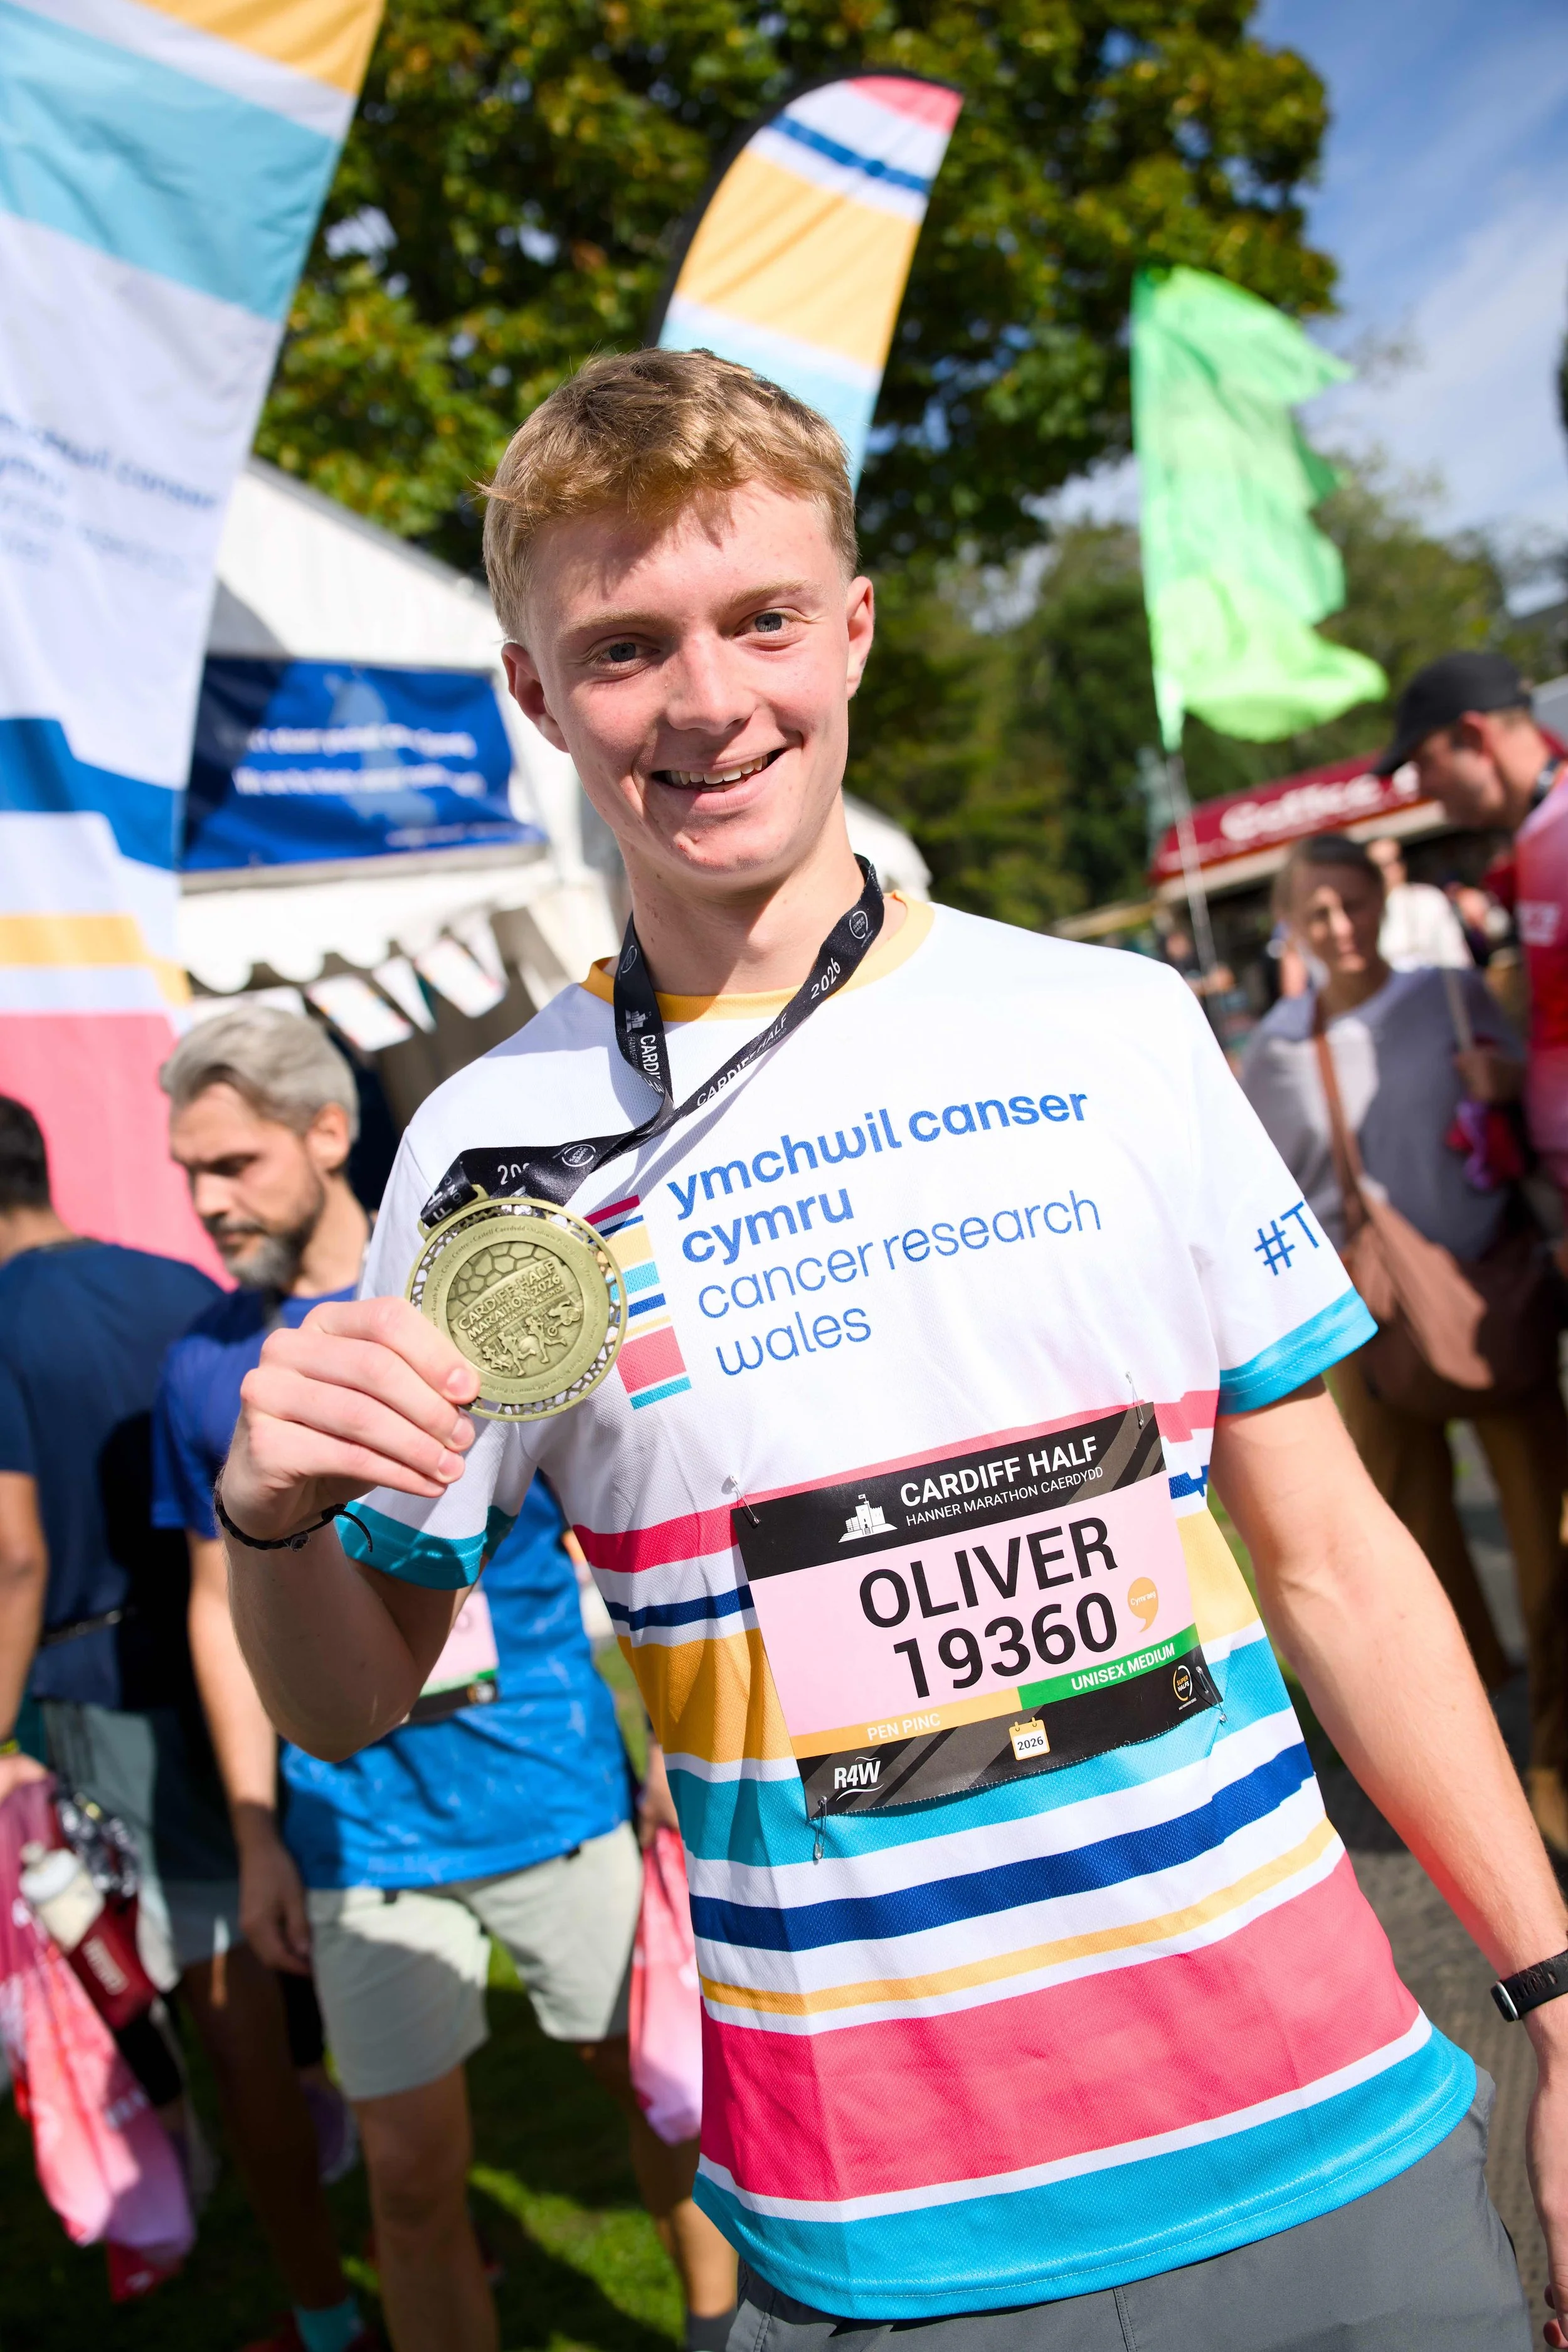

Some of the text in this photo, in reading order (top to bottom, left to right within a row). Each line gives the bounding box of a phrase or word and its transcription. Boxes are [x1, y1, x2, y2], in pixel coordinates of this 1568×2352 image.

[811, 957, 841, 1000] 2026
[758, 1013, 787, 1052] HALF
[640, 1035, 661, 1079] CARDI
[667, 1093, 1088, 1221] ymchwil canser
[682, 1189, 854, 1265] cymru
[699, 1190, 1102, 1319] cancer research
[716, 1307, 872, 1376] wales
[901, 1437, 1098, 1508] CARDIFF HALF
[906, 1466, 1104, 1527] HANNER MARATHON CAERDYDD
[859, 1517, 1118, 1629] OLIVER
[1130, 1589, 1157, 1607] Cymraeg
[894, 1592, 1117, 1698] 19360
[1071, 1643, 1175, 1691] UNISEX MEDIUM
[1176, 1675, 1189, 1686] SUPER
[1177, 1681, 1190, 1692] HALFS
[867, 1713, 941, 1742] PEN PINC
[1017, 1735, 1044, 1751] 2026
[834, 1759, 881, 1790] R4W
